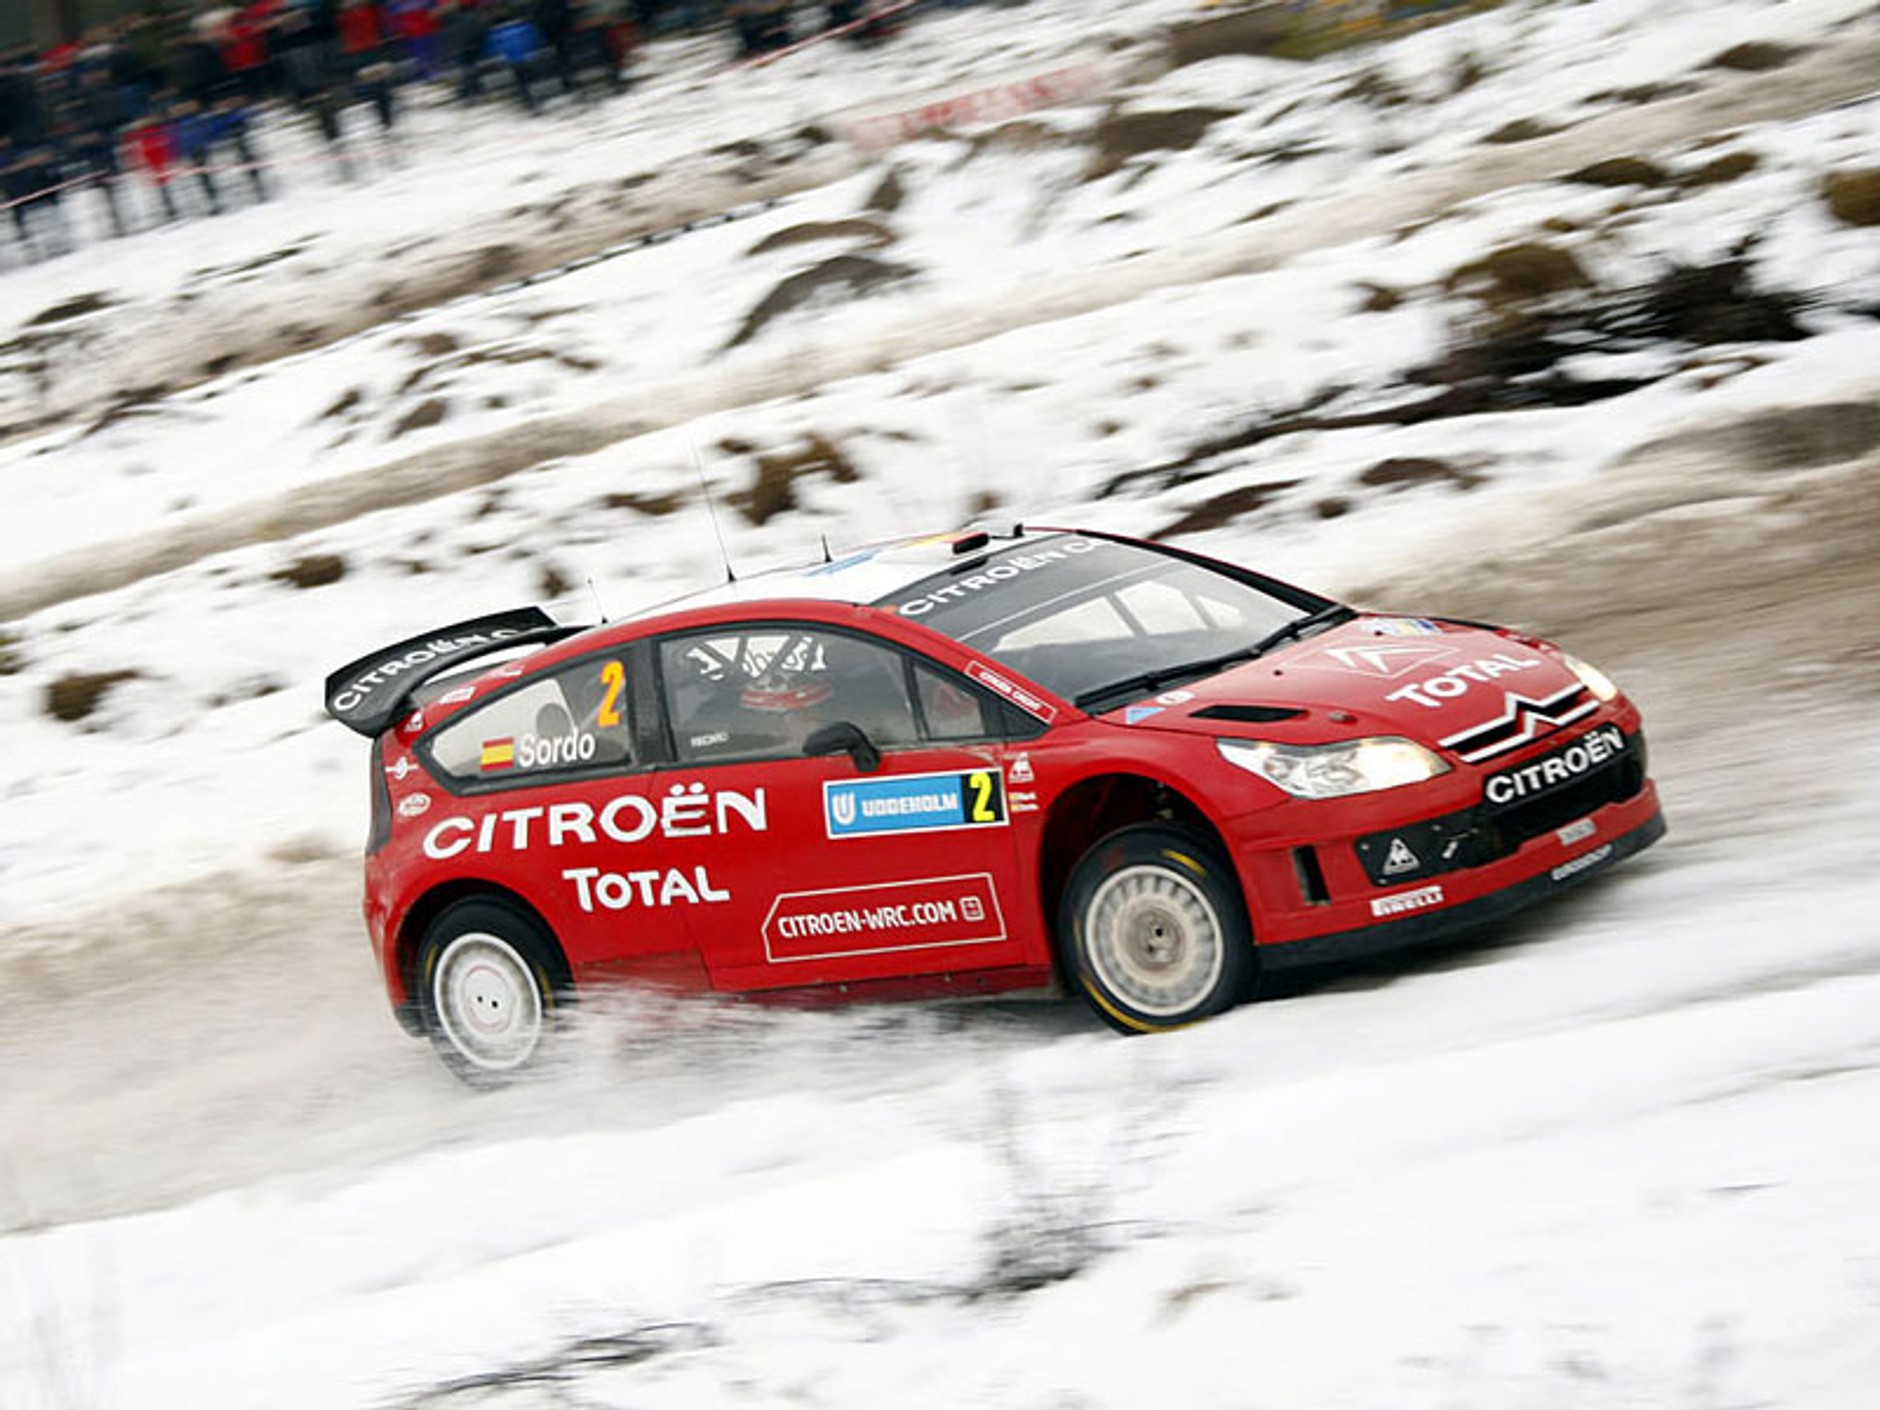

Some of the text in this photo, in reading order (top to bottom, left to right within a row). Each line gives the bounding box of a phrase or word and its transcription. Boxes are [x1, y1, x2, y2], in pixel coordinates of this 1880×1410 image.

[899, 550, 1068, 616] CITROËN
[597, 659, 626, 727] 2
[1384, 653, 1541, 707] TOTAL
[518, 730, 595, 768] Sordo
[1486, 727, 1624, 804] CITROËN
[423, 782, 768, 859] CITROËN
[969, 771, 995, 822] 2
[562, 866, 731, 913] TOTAL
[777, 900, 958, 938] CITROEN-WRC.COM
